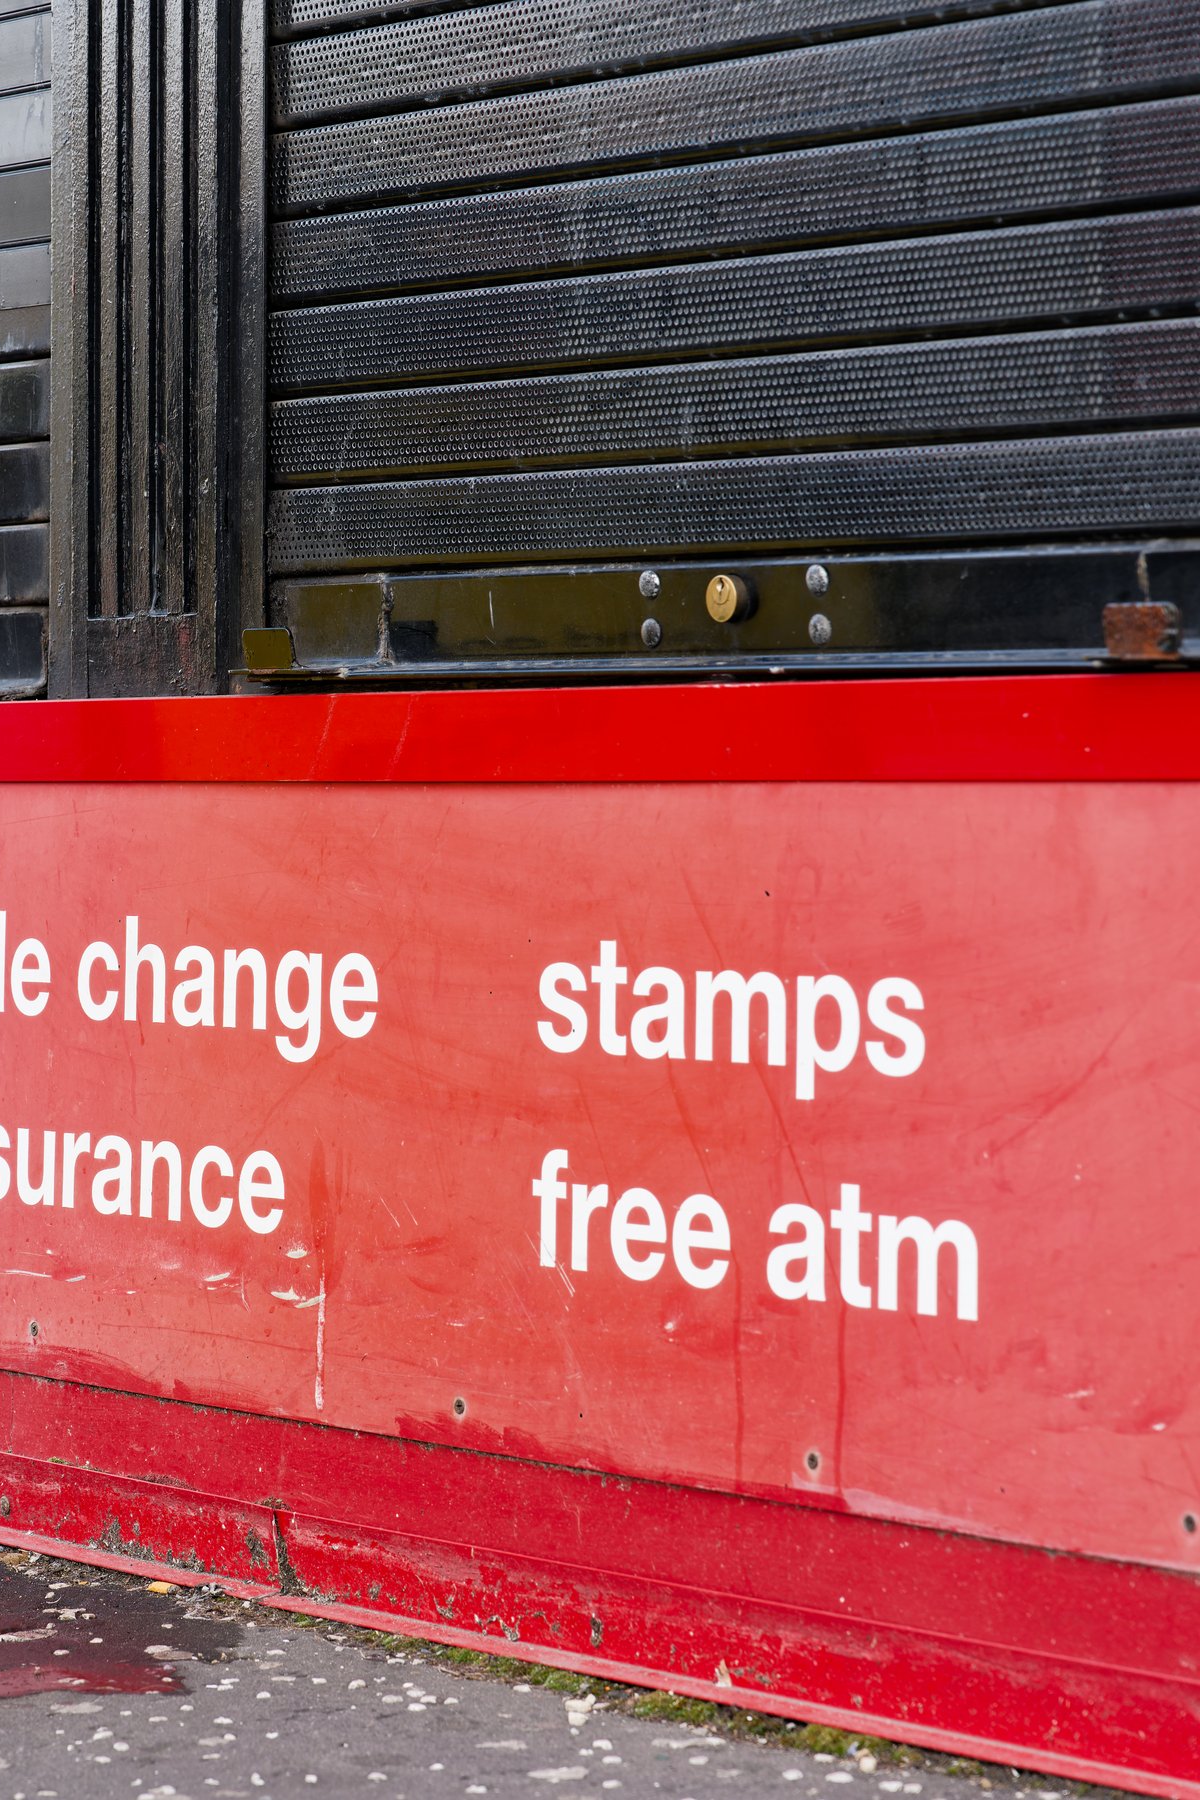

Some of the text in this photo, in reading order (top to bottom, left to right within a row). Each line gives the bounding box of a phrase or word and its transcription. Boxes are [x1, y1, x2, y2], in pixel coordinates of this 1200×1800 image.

[77, 915, 379, 1064] change
[536, 939, 926, 1102] stamps
[531, 1148, 979, 1322] free atm
